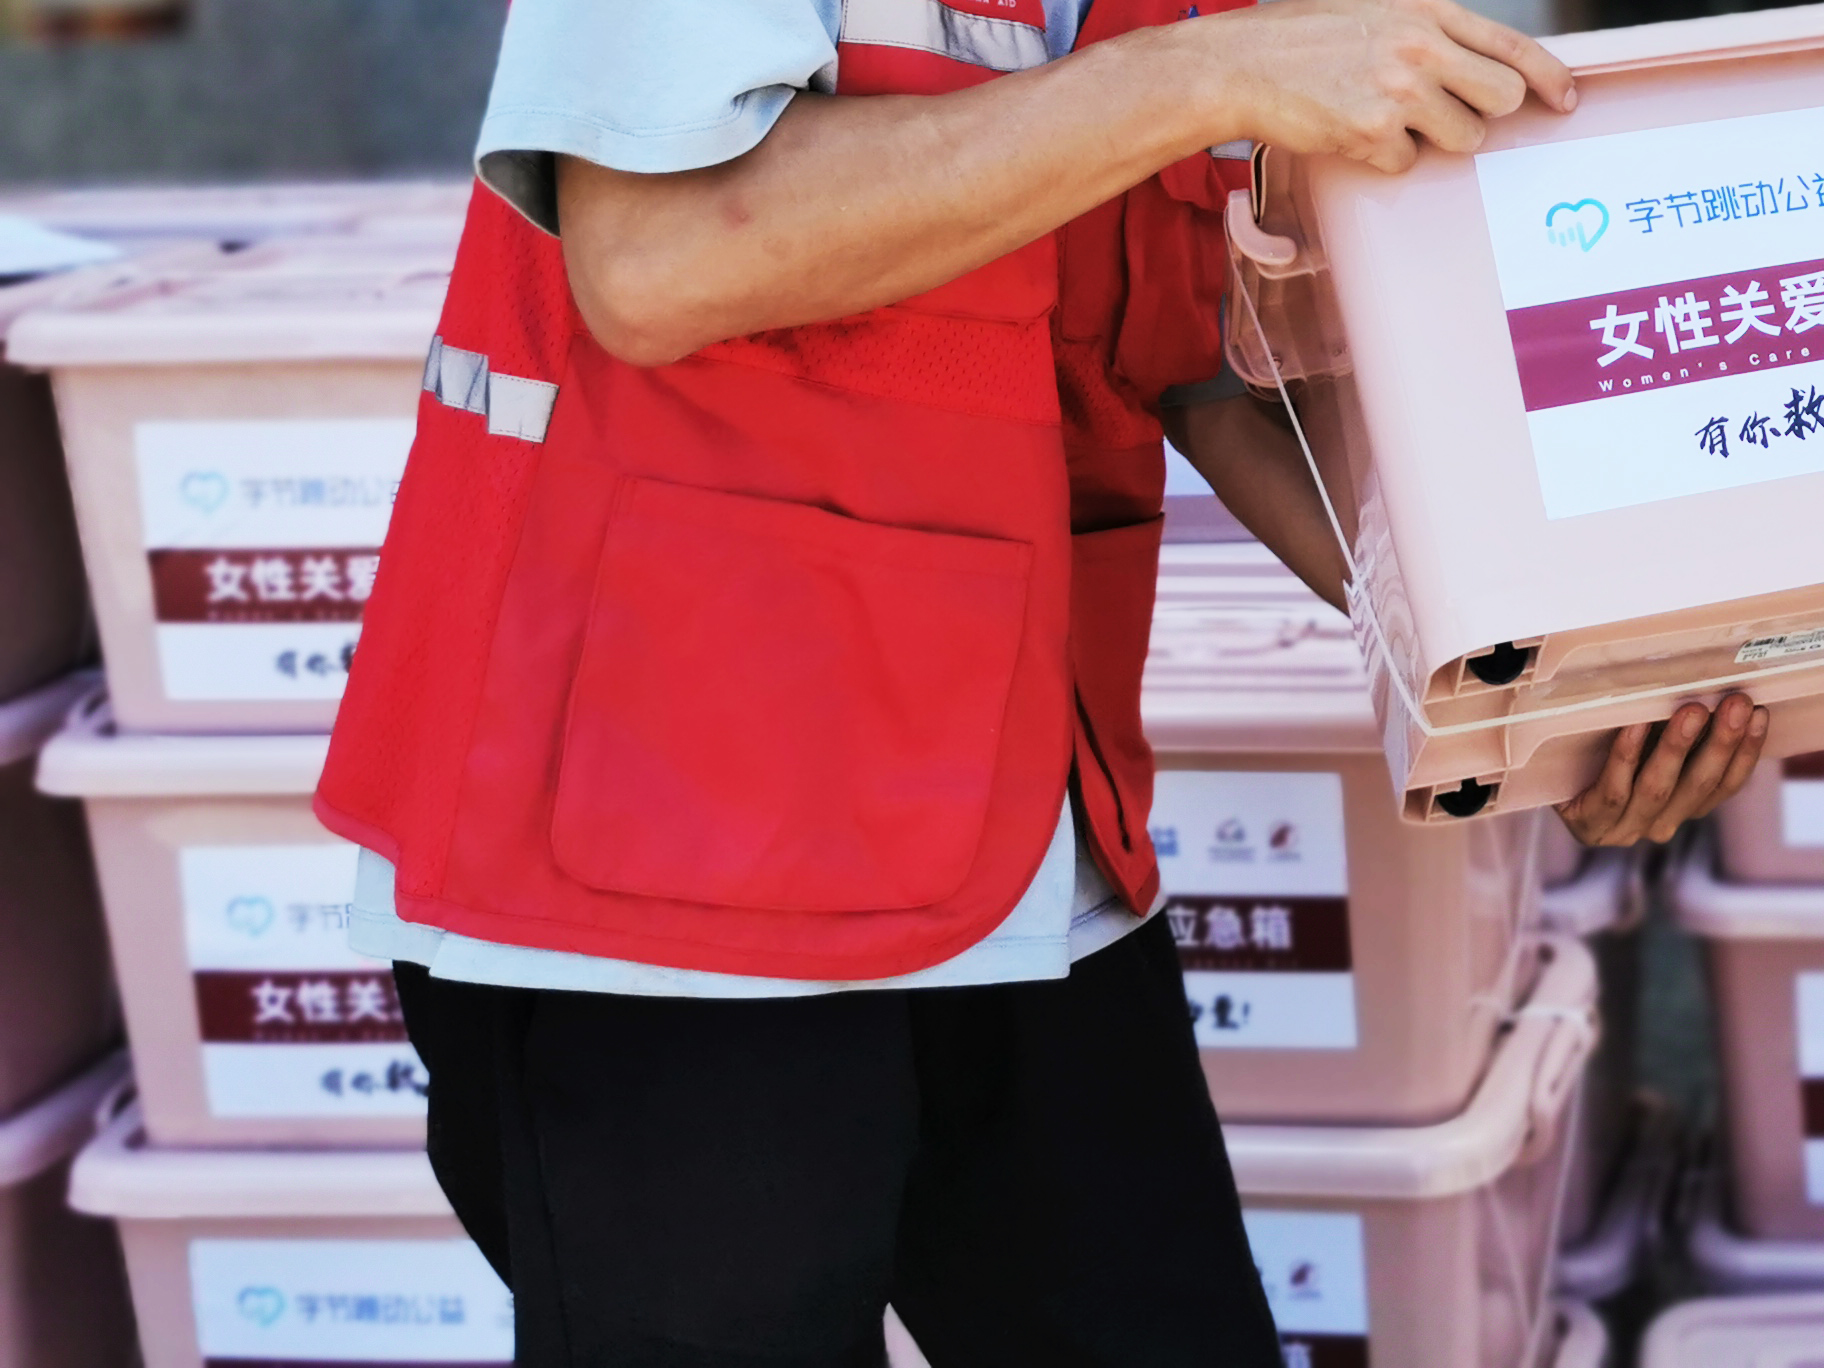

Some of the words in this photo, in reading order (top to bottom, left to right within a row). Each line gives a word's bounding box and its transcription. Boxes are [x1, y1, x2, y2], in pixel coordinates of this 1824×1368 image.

[1598, 360, 1729, 393] Women's
[1748, 345, 1811, 367] Care
[250, 980, 405, 1025] 女性关
